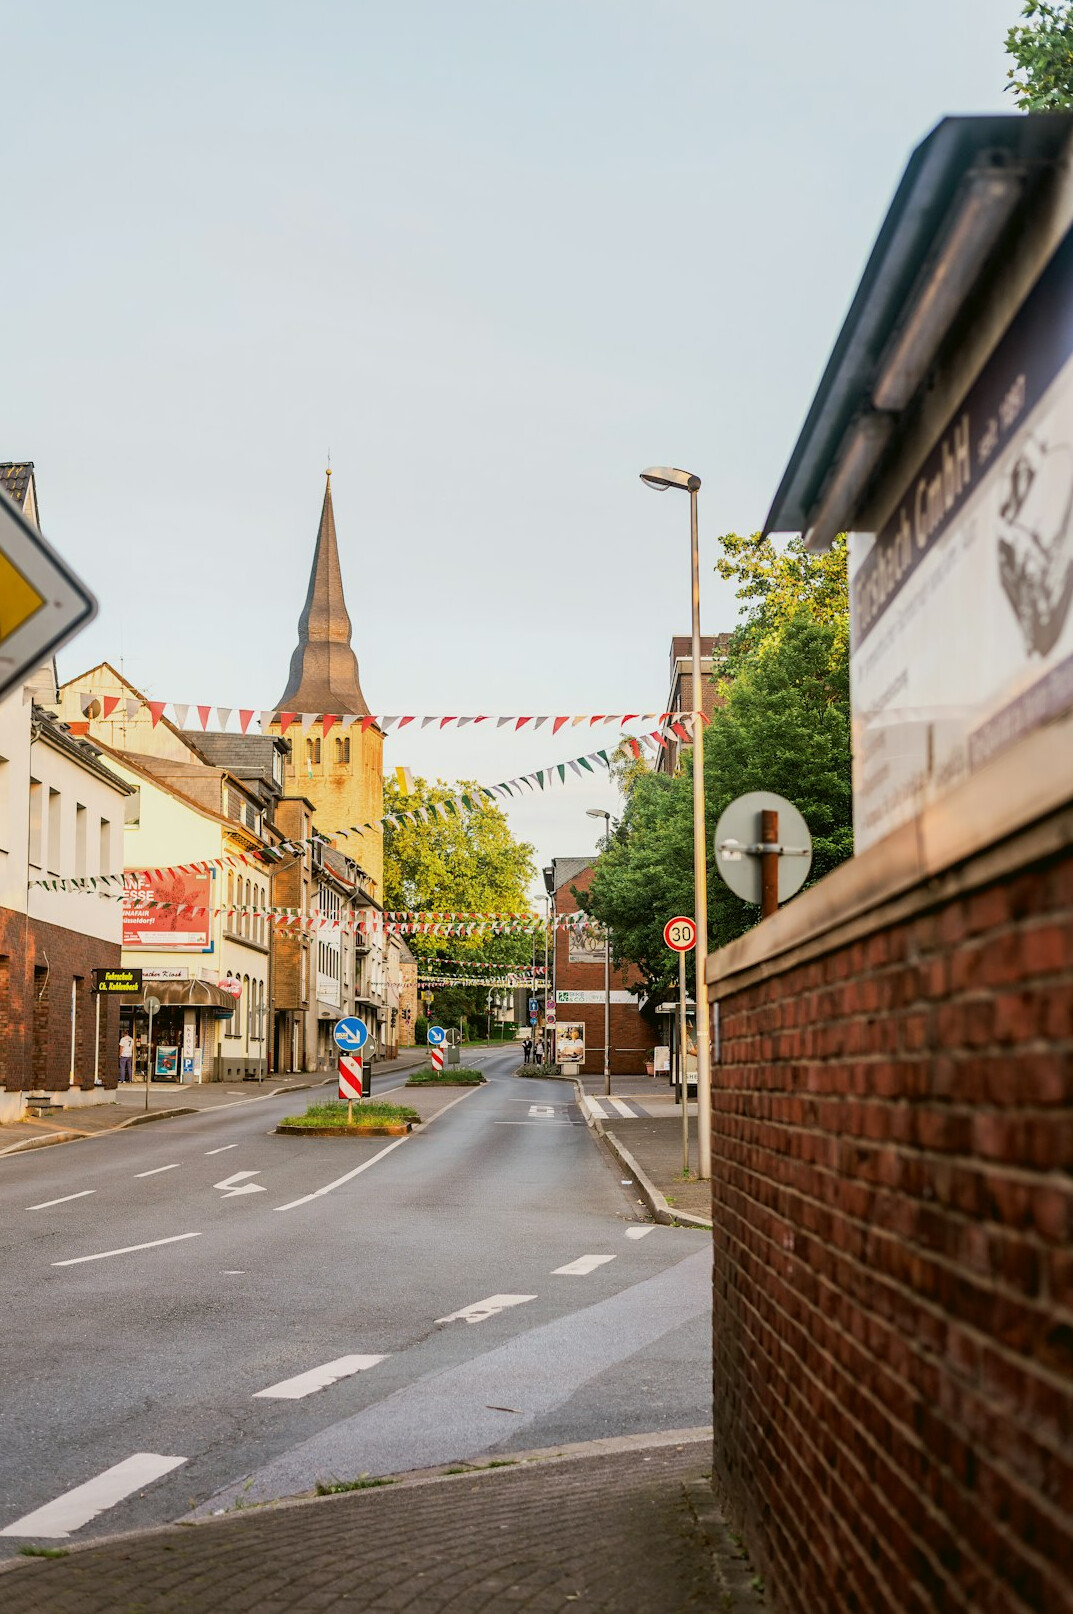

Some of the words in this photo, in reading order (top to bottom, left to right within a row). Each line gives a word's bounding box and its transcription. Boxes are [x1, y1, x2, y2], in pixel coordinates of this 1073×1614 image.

[915, 412, 970, 549] GmbH
[122, 890, 154, 901] ESSE
[122, 917, 155, 925] üsseldorf!
[671, 926, 691, 942] 30
[105, 972, 133, 981] Fahrschule
[162, 970, 181, 978] Kiosk
[185, 1059, 191, 1068] P
